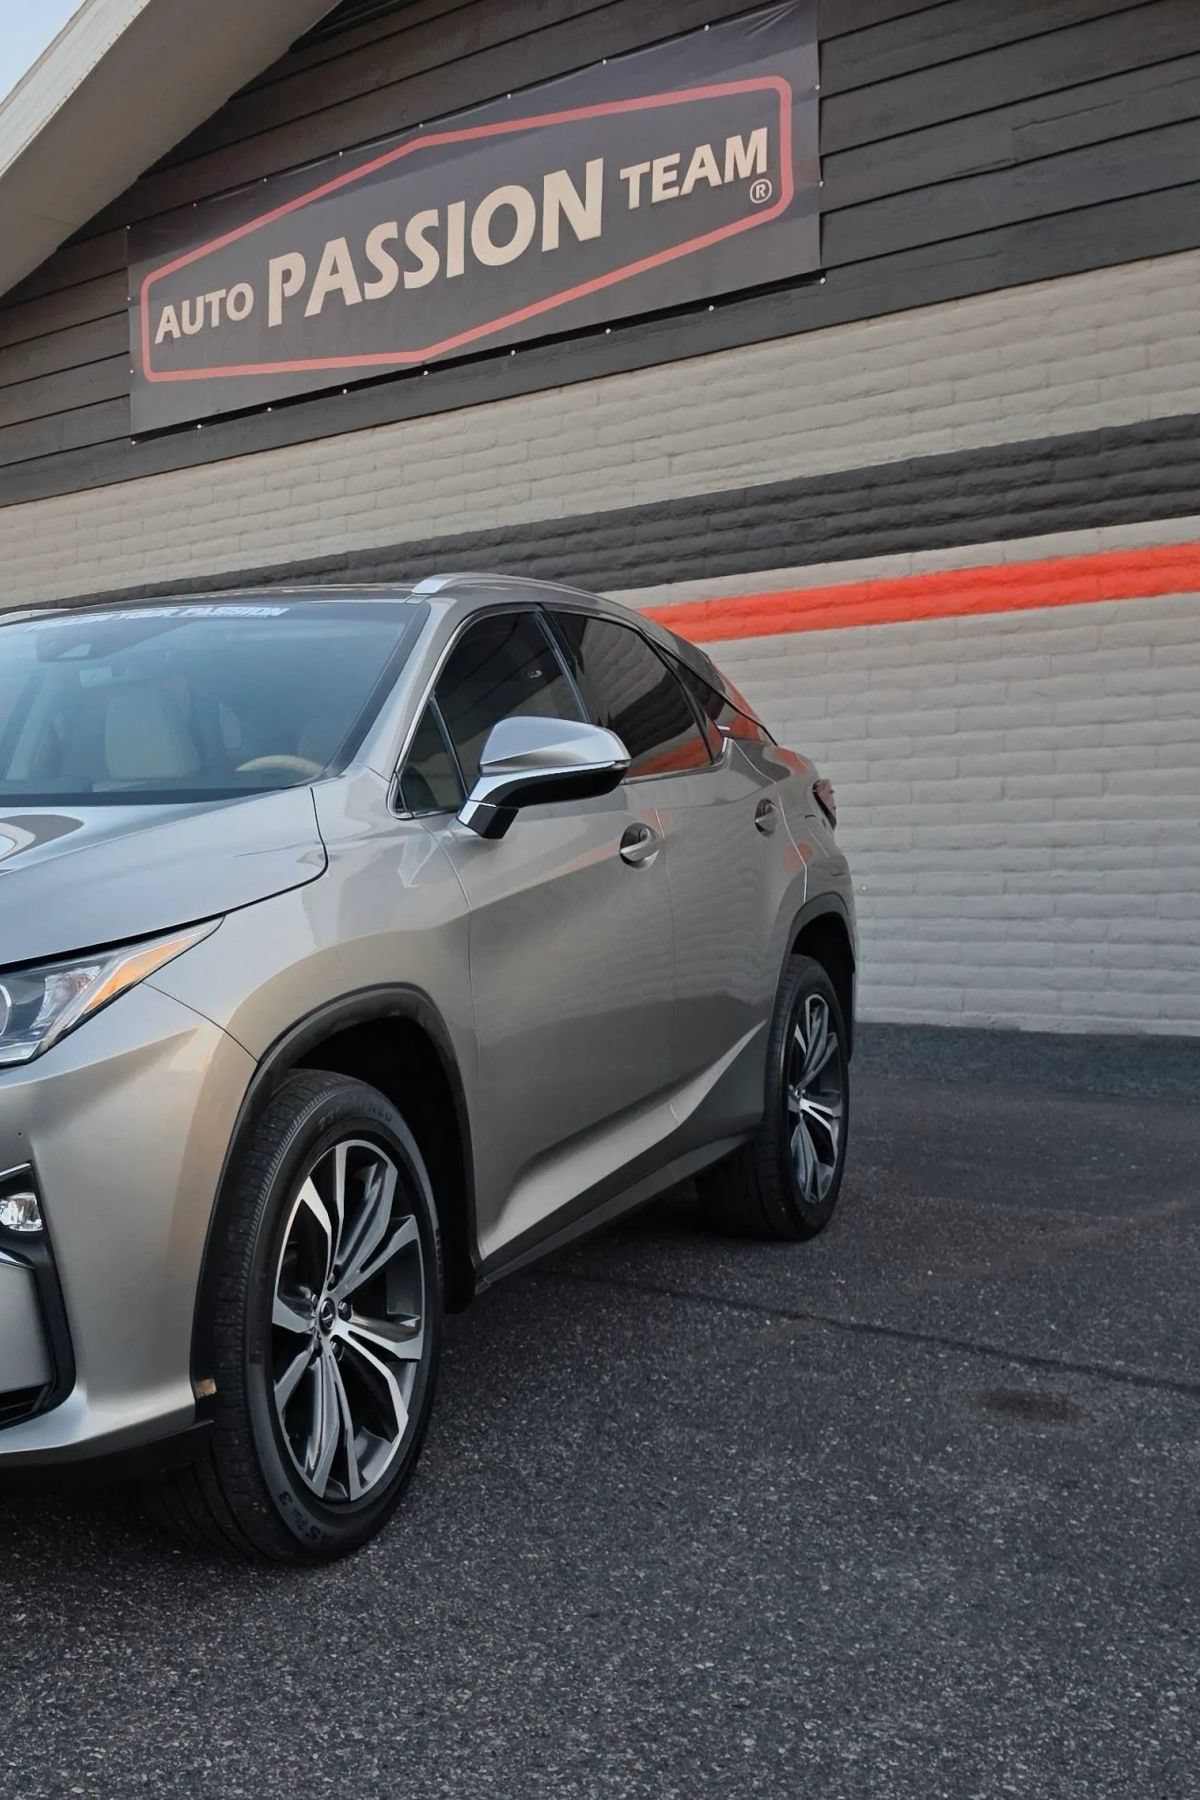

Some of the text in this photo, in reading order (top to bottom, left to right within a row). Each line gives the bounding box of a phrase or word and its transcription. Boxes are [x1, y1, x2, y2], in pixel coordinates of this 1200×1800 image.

[155, 127, 769, 344] AUTO PASSION TEAM
